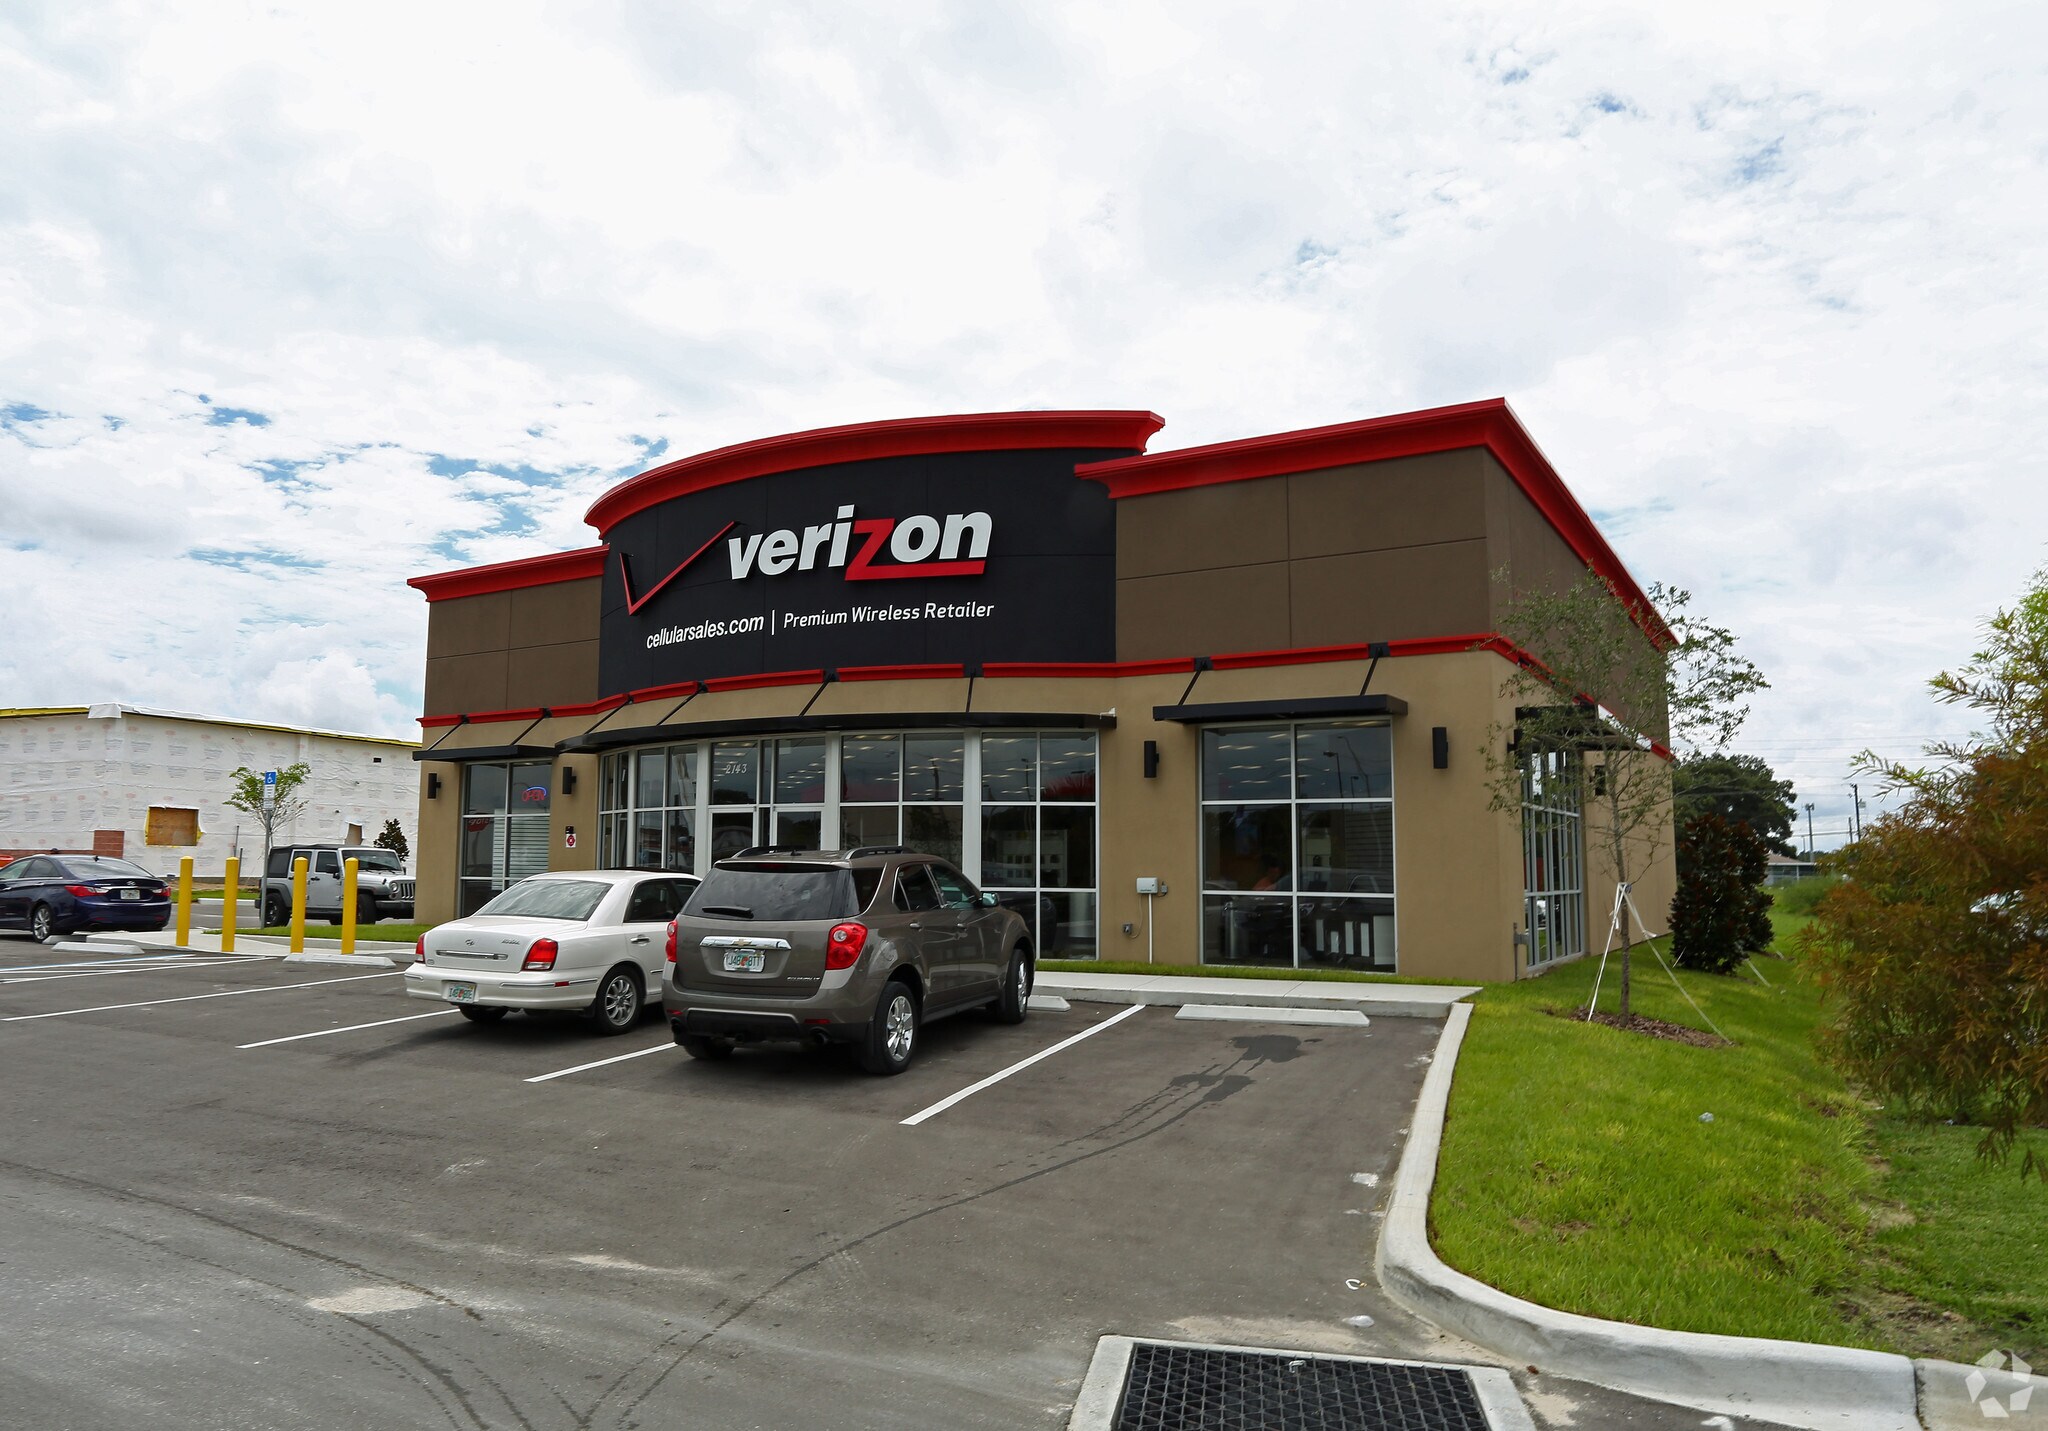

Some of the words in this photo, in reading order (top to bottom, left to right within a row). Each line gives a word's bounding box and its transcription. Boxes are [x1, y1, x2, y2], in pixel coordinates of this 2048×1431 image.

[727, 503, 993, 581] verizon
[646, 615, 765, 649] cellularsales.com
[783, 609, 848, 629] Premium
[851, 604, 921, 623] Wireless
[923, 600, 995, 619] Retailer
[725, 763, 748, 774] 2143
